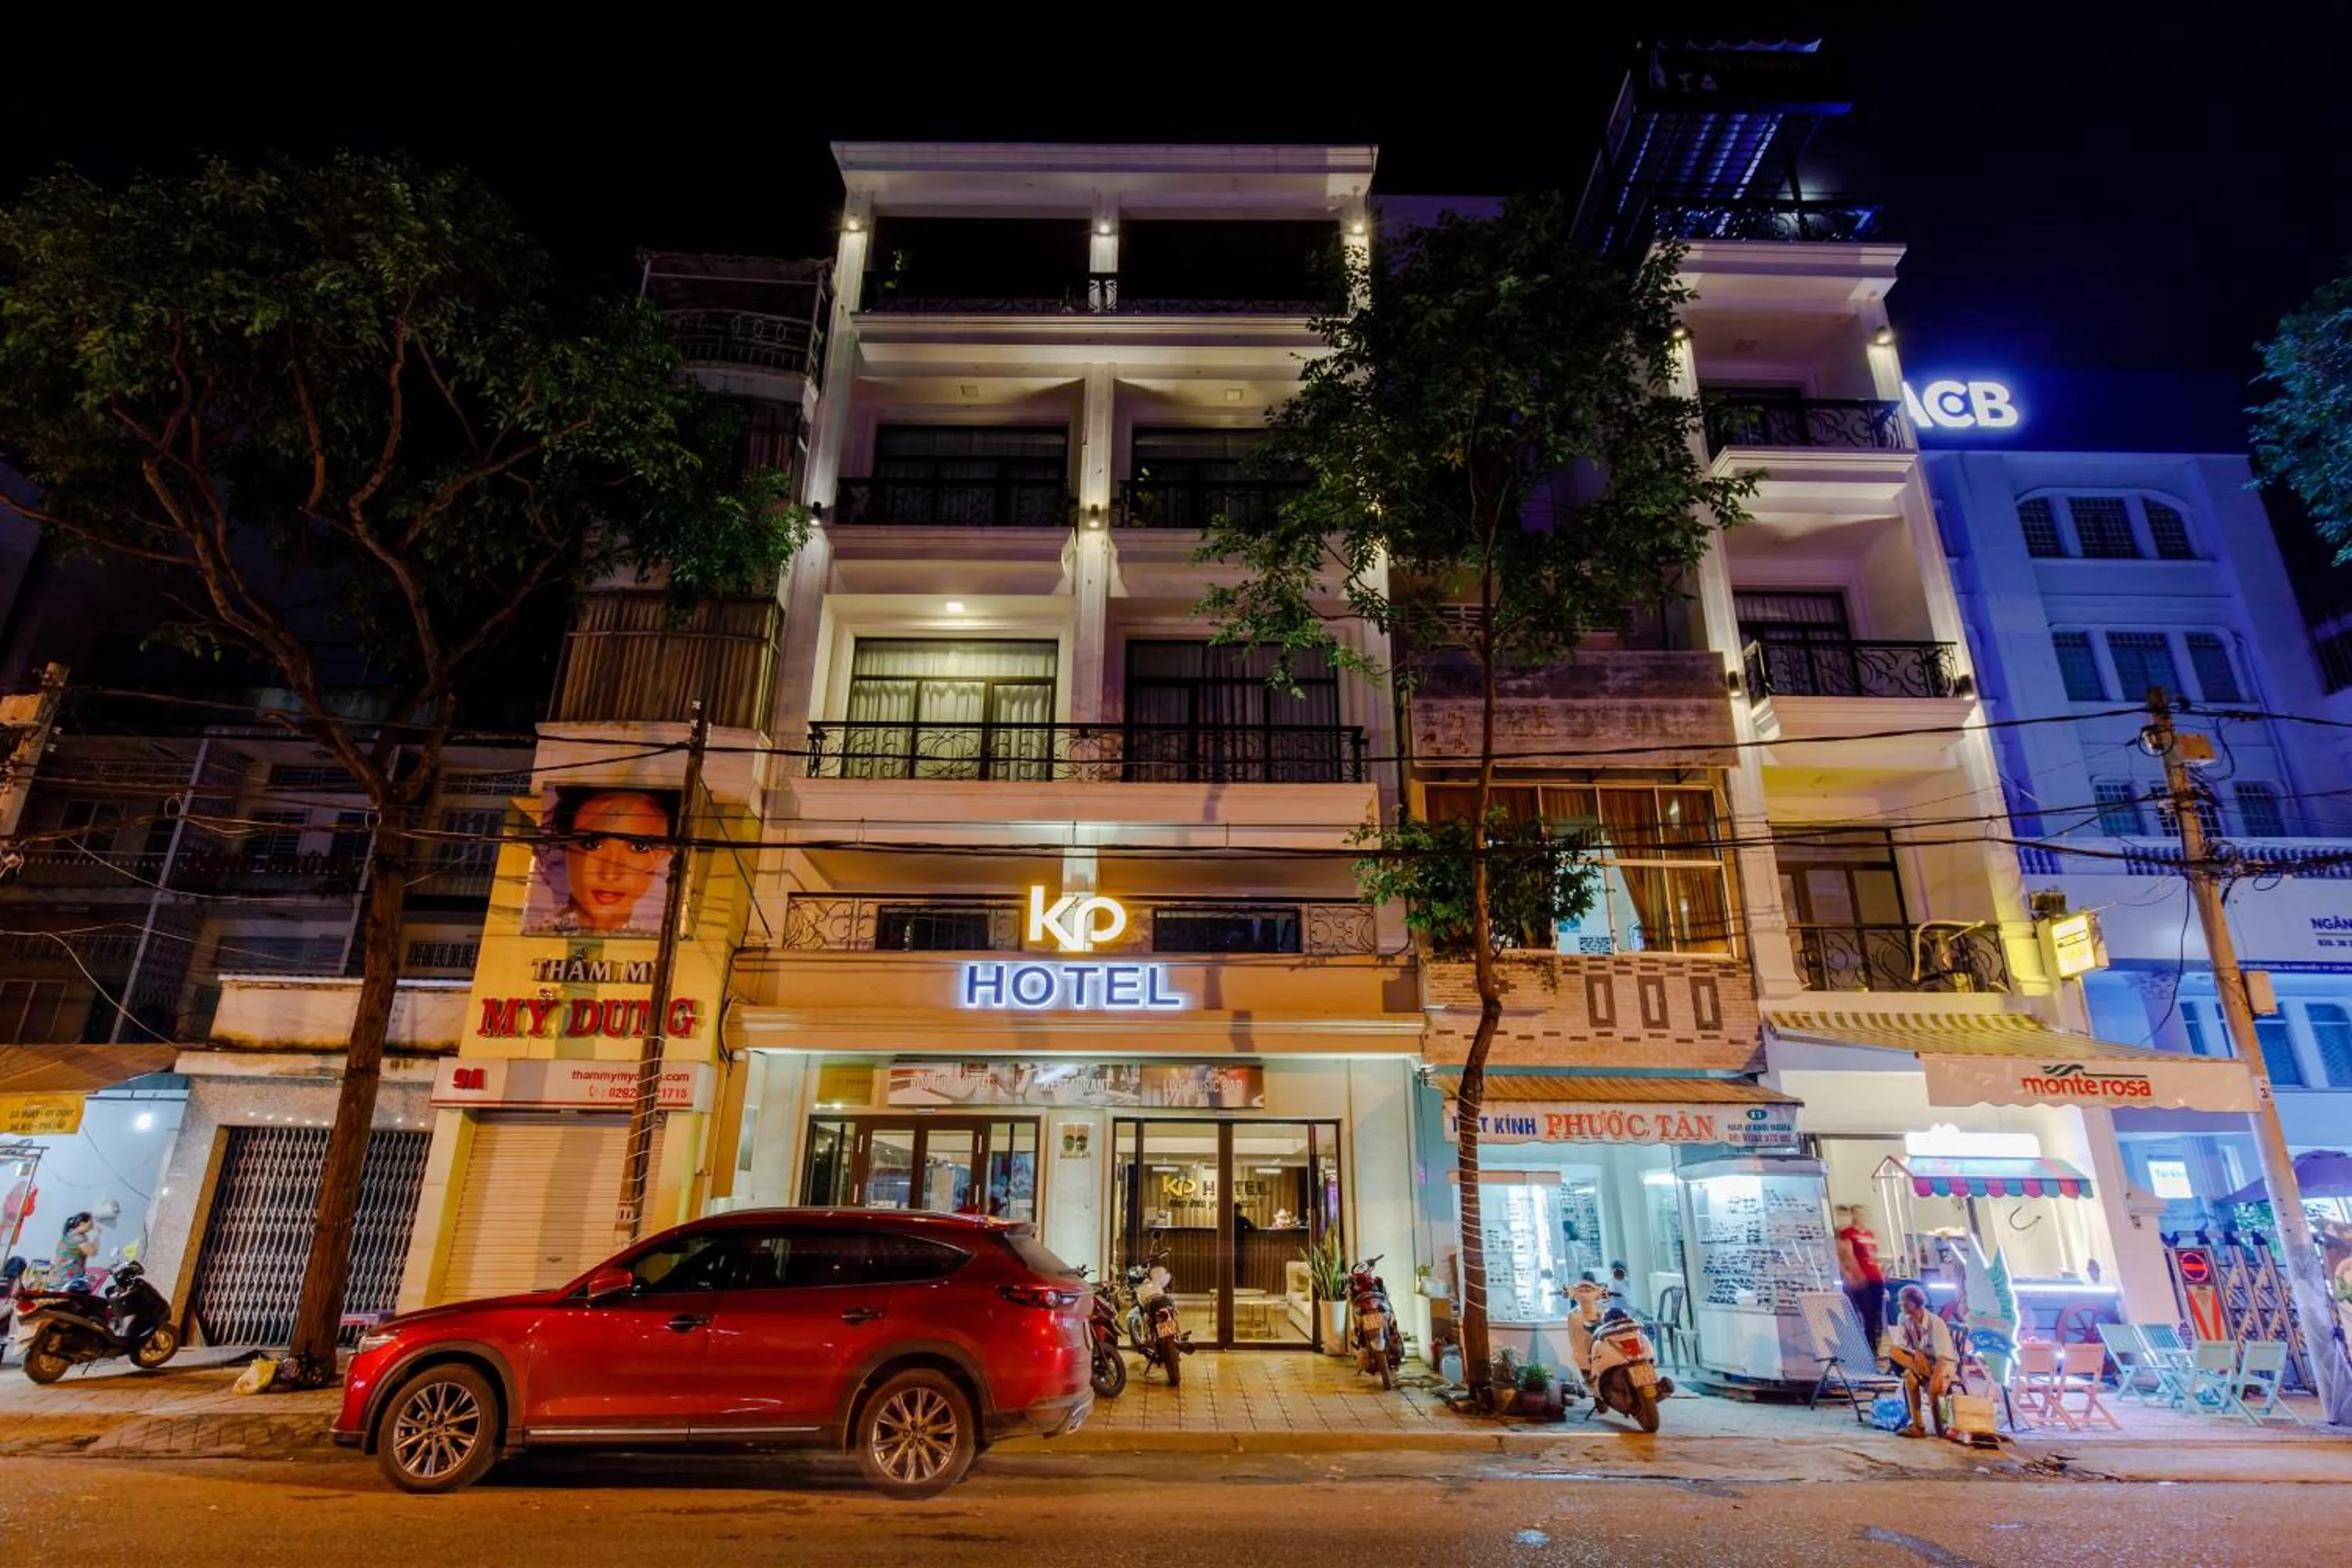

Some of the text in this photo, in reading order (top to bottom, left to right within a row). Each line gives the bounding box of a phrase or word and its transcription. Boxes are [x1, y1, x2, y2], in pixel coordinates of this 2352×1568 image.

[965, 964, 1182, 1007] HOTEL
[452, 1068, 485, 1091] 9A
[1163, 1078, 1243, 1093] LIVE MUSIC BAR
[2020, 1073, 2153, 1097] monte rosa
[1494, 1112, 1537, 1135] KÍNH
[1202, 1180, 1268, 1196] HTEL
